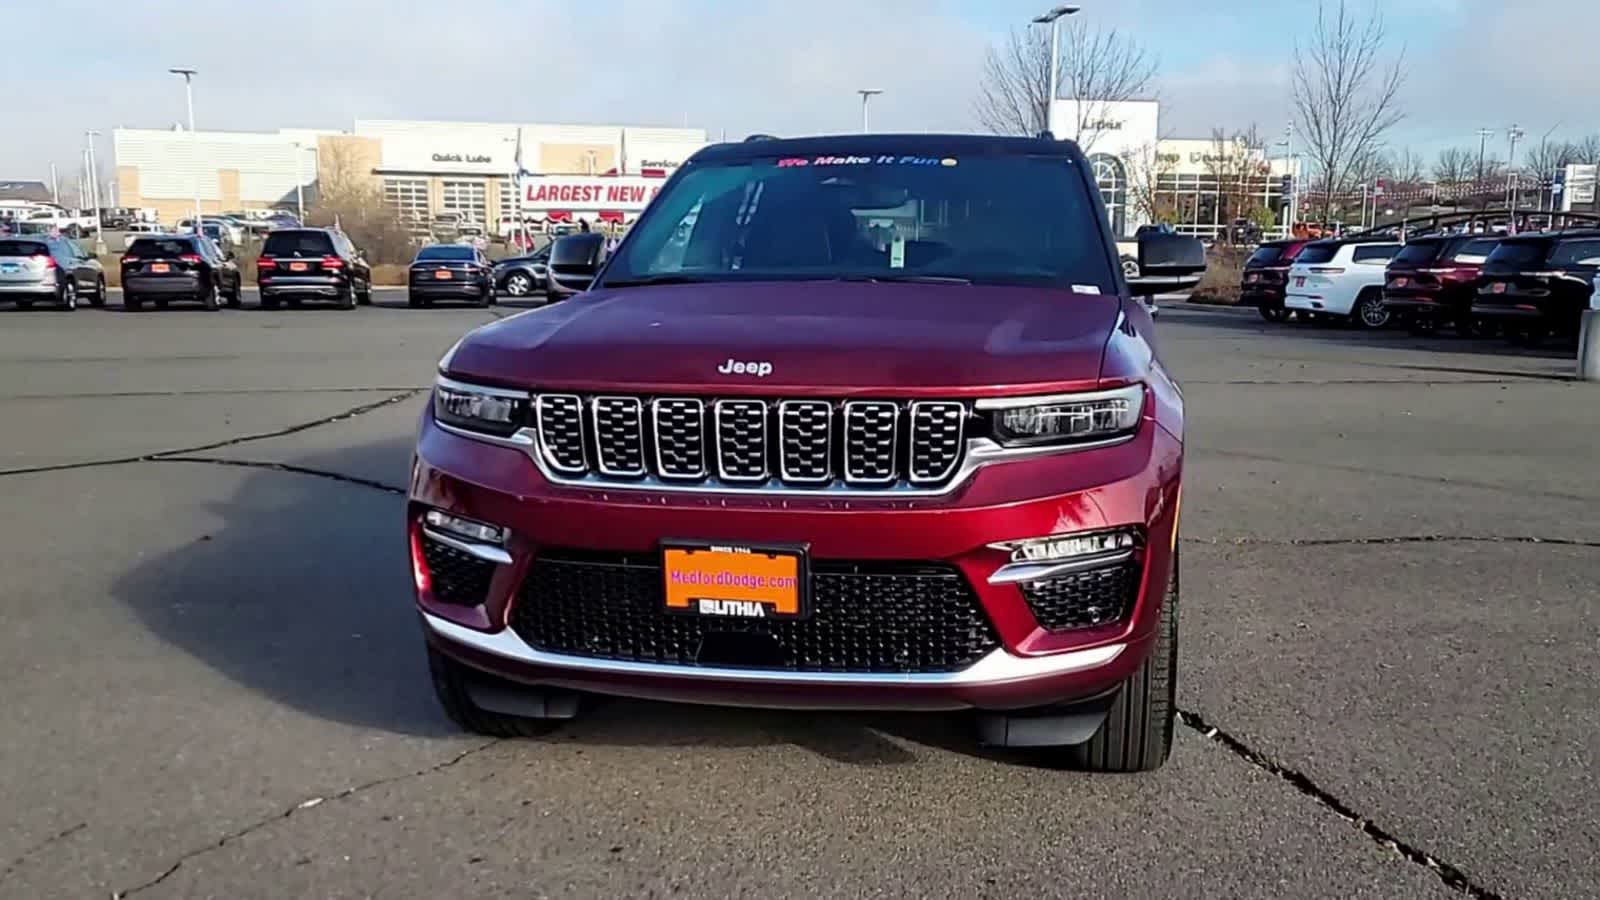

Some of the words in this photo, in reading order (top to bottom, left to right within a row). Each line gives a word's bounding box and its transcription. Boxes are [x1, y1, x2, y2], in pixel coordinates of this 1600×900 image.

[431, 153, 462, 162] Quick
[465, 154, 492, 163] Lube
[640, 159, 679, 168] Service
[776, 157, 808, 168] We
[813, 155, 871, 165] Make
[876, 155, 895, 164] It
[899, 156, 939, 166] Fun
[526, 185, 603, 201] LARGEST
[607, 186, 646, 202] NEW
[718, 359, 772, 376] Jeep
[671, 570, 798, 588] MedfordDodge.com
[715, 600, 765, 617] LITHIA
